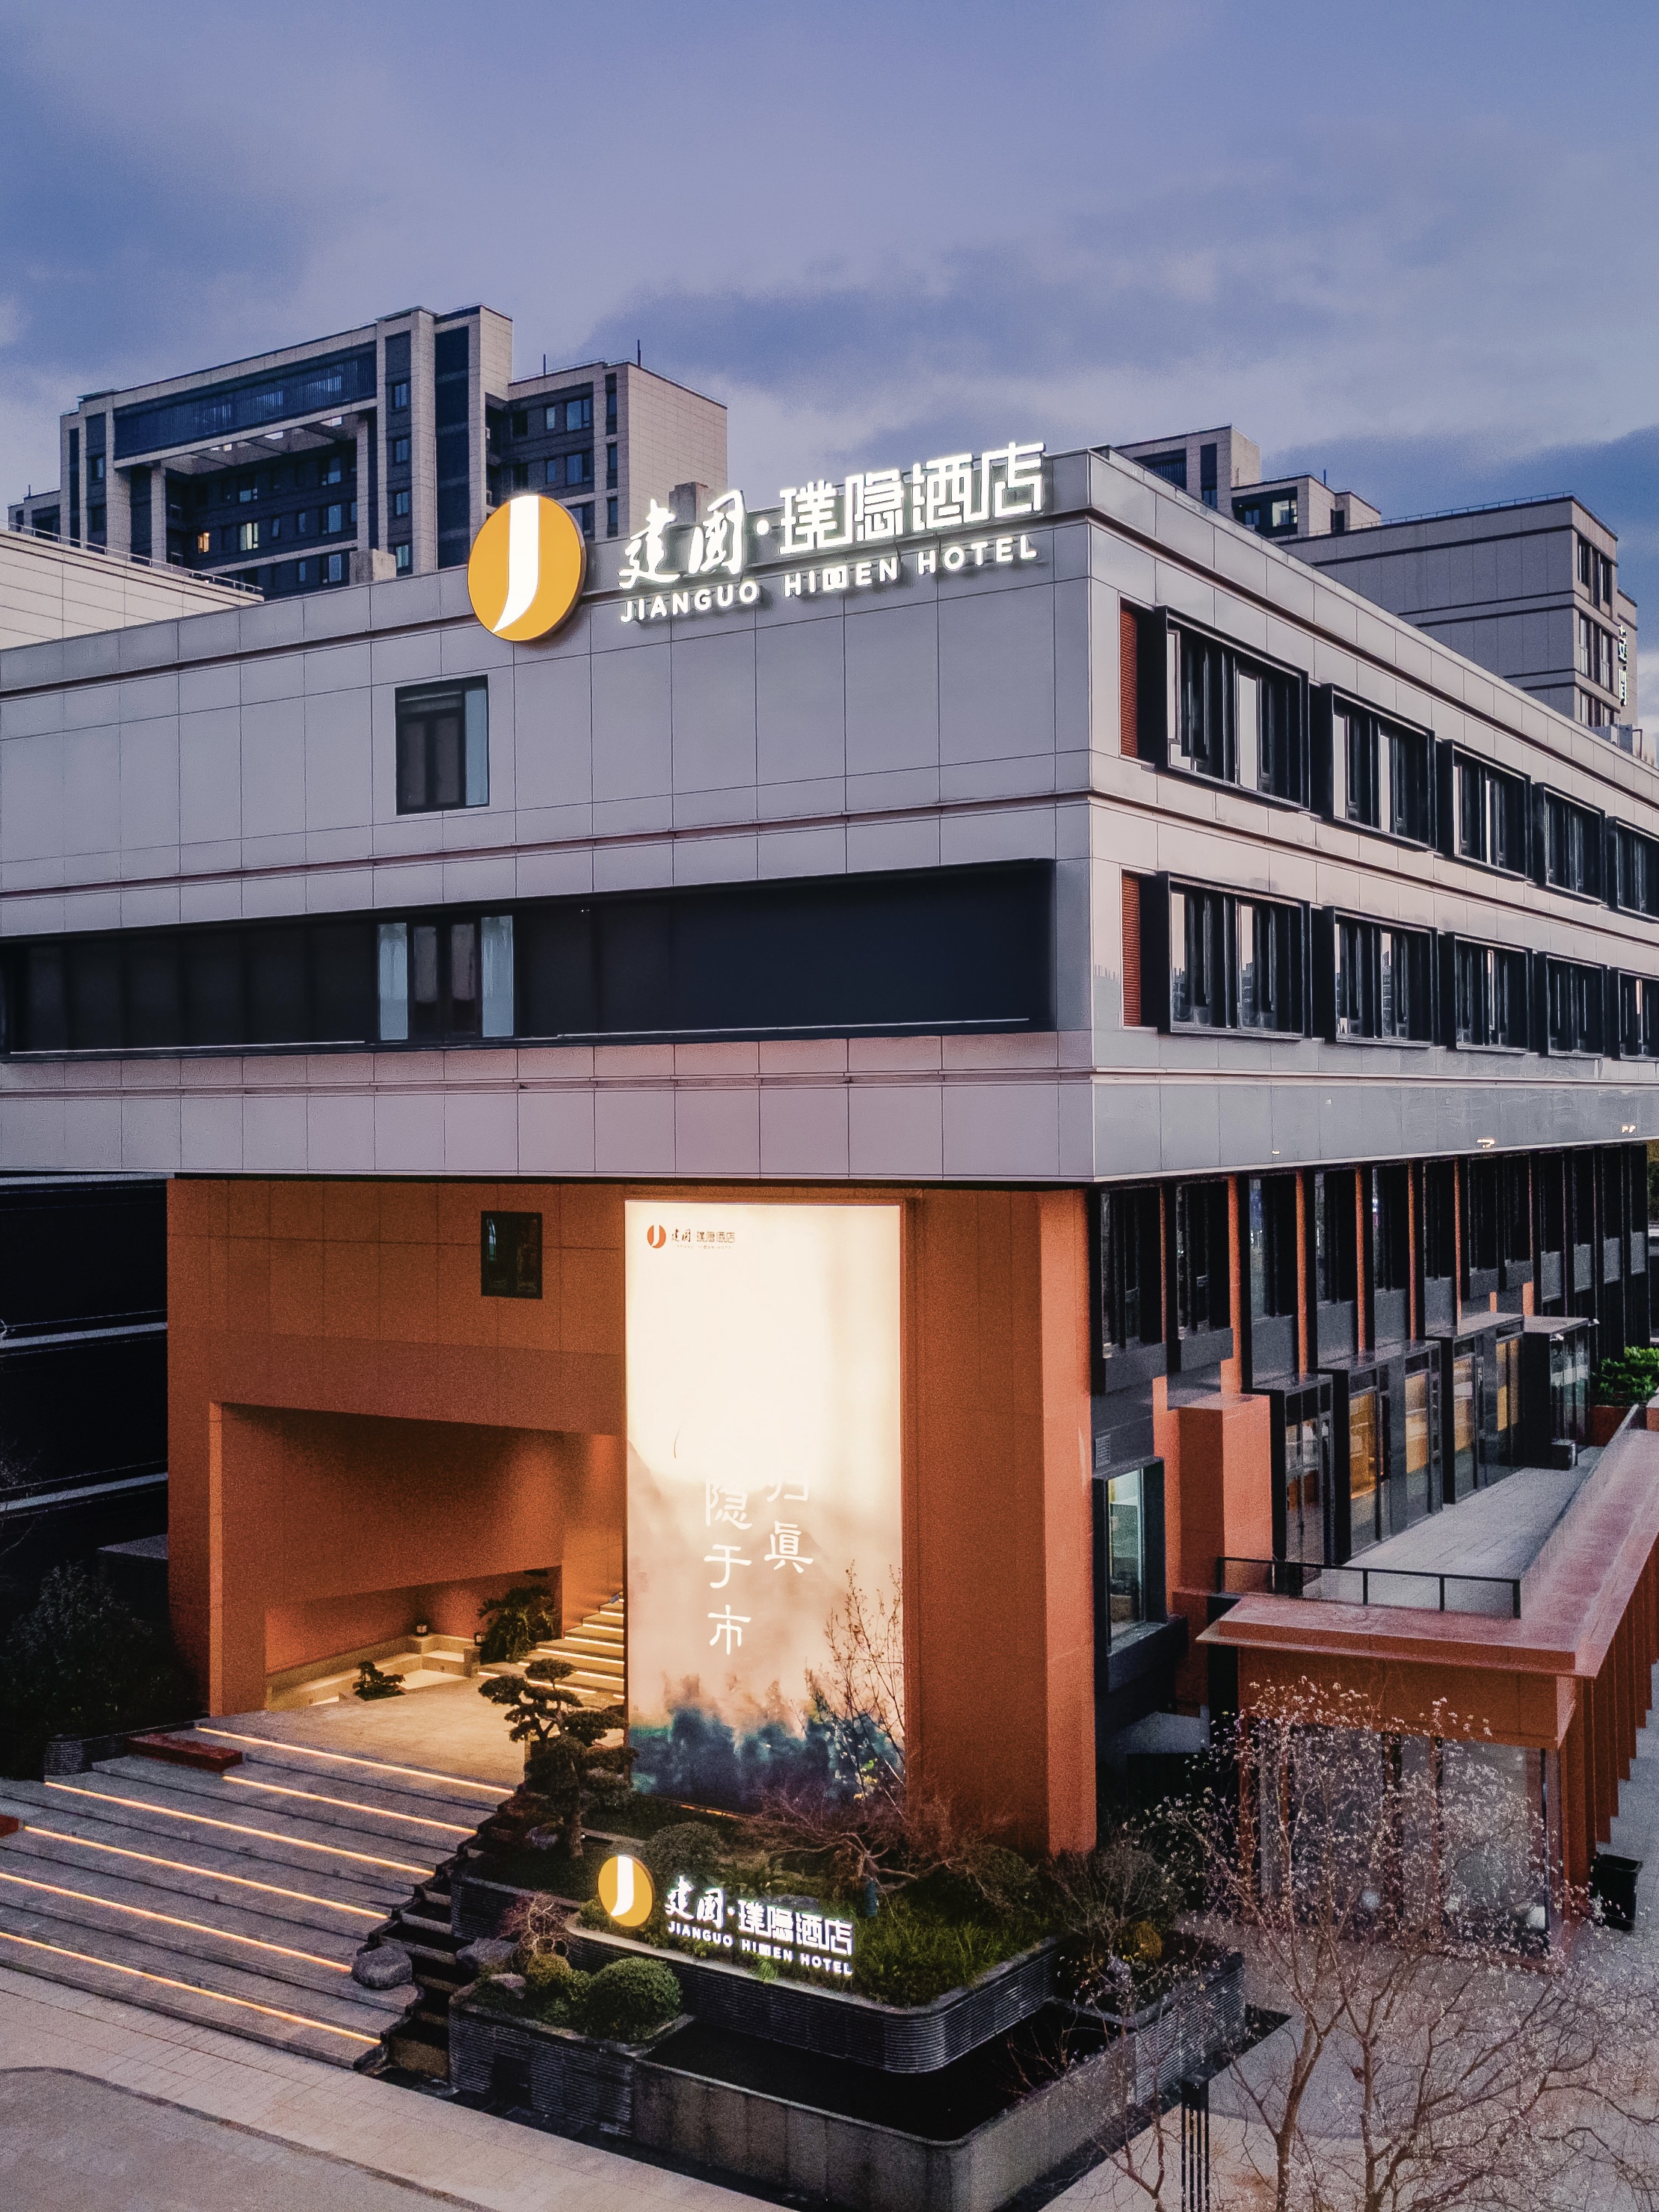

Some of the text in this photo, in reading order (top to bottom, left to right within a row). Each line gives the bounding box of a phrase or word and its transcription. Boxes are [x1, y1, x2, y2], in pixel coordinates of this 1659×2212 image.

[620, 580, 760, 624] JIANGUO
[918, 535, 1037, 574] HOTEL
[704, 1478, 753, 1656] 隐于市
[668, 1921, 733, 1947] JIANGUO
[800, 1953, 853, 1976] HOTEL
